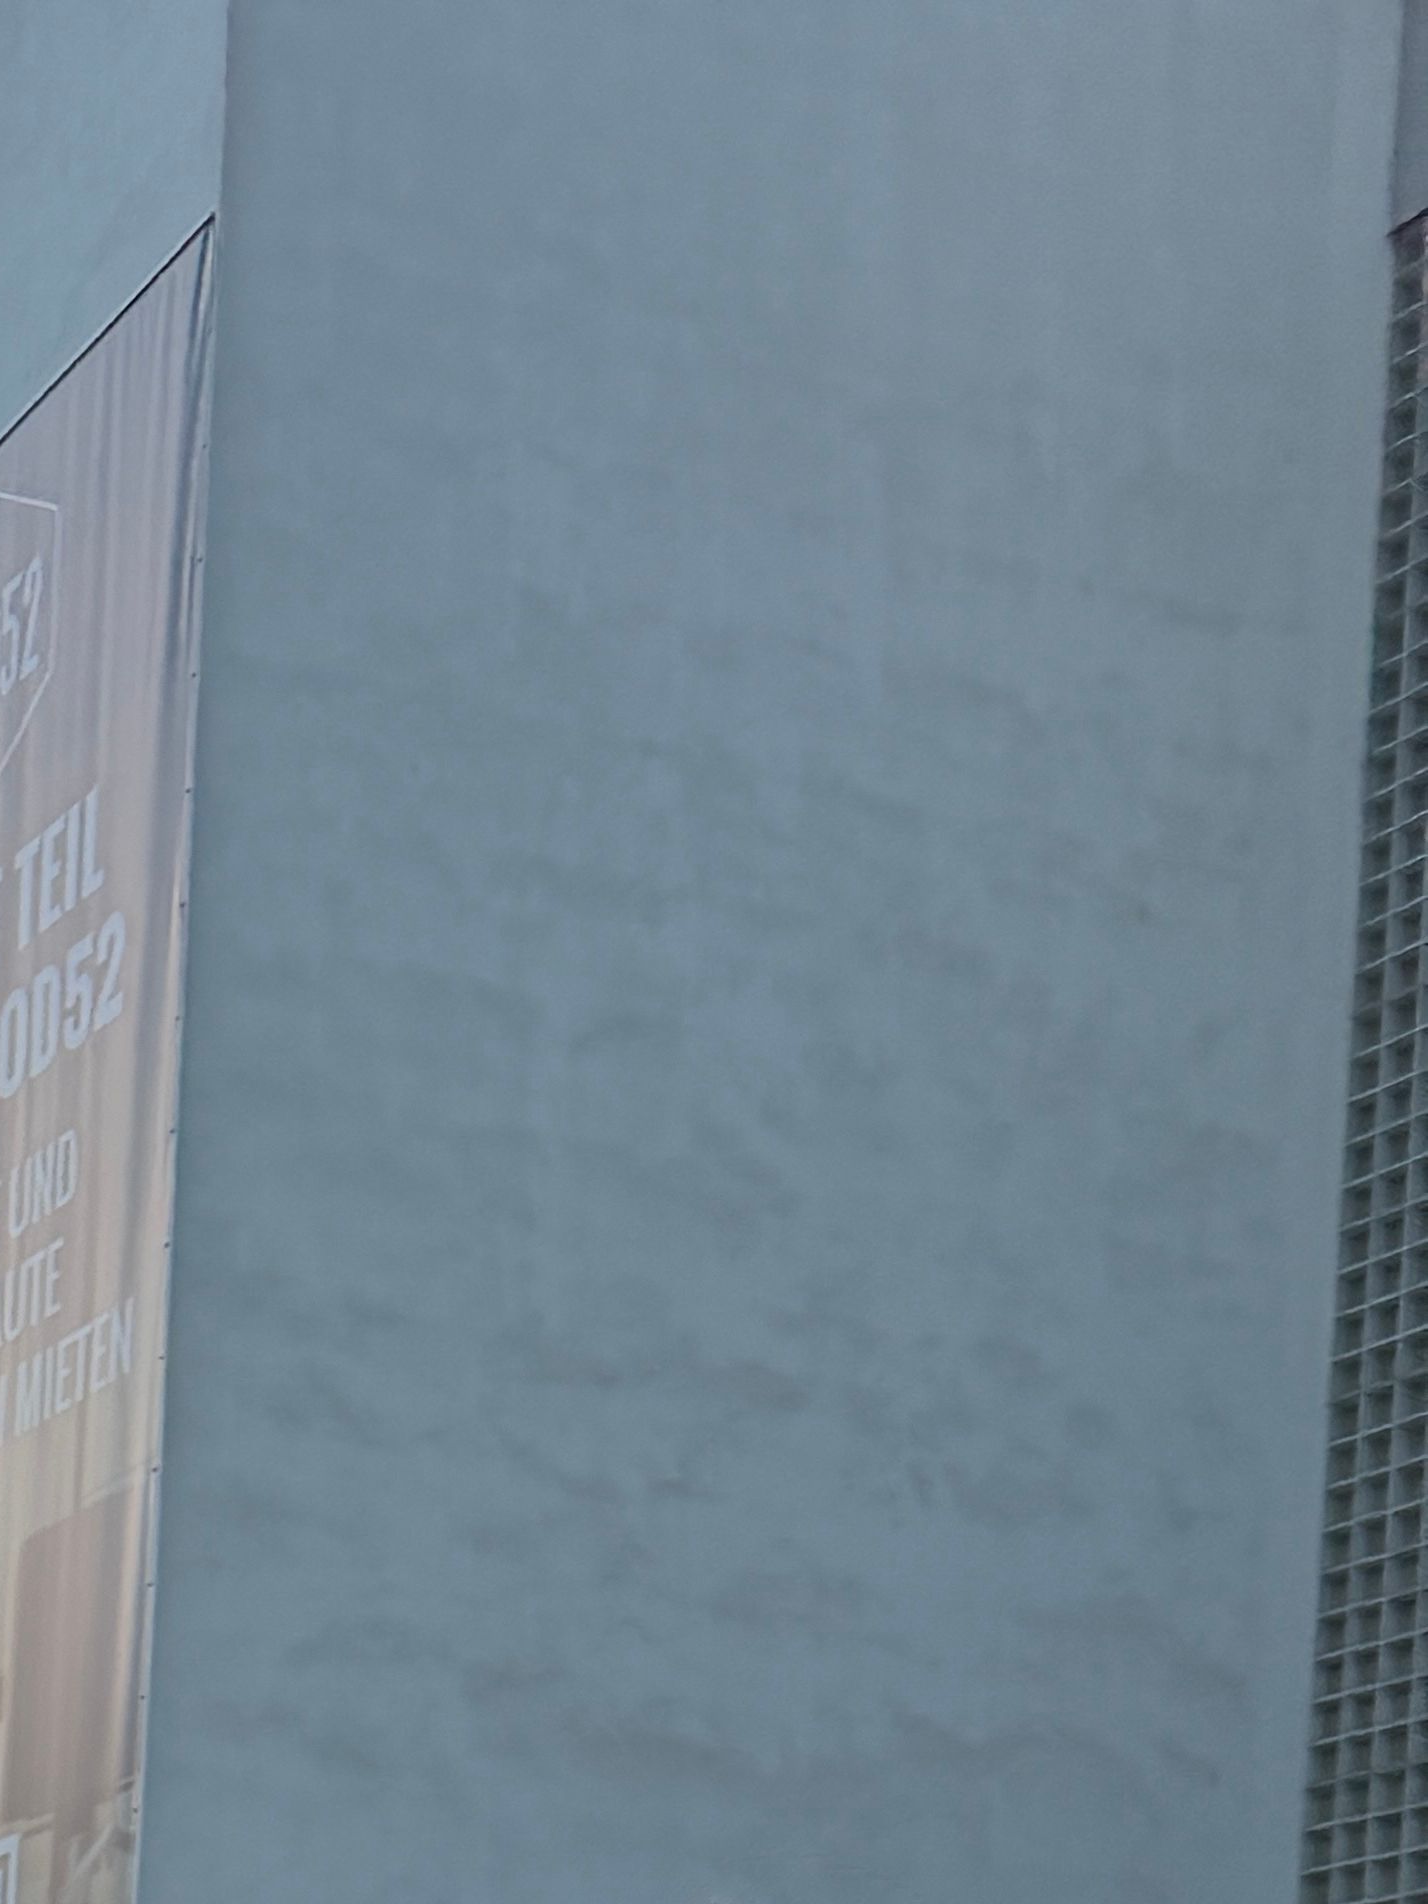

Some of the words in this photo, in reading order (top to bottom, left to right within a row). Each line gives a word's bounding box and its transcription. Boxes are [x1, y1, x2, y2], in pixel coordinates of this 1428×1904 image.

[14, 783, 105, 951] TEIL
[9, 1129, 77, 1239] UND
[13, 1296, 136, 1437] MIETEN
